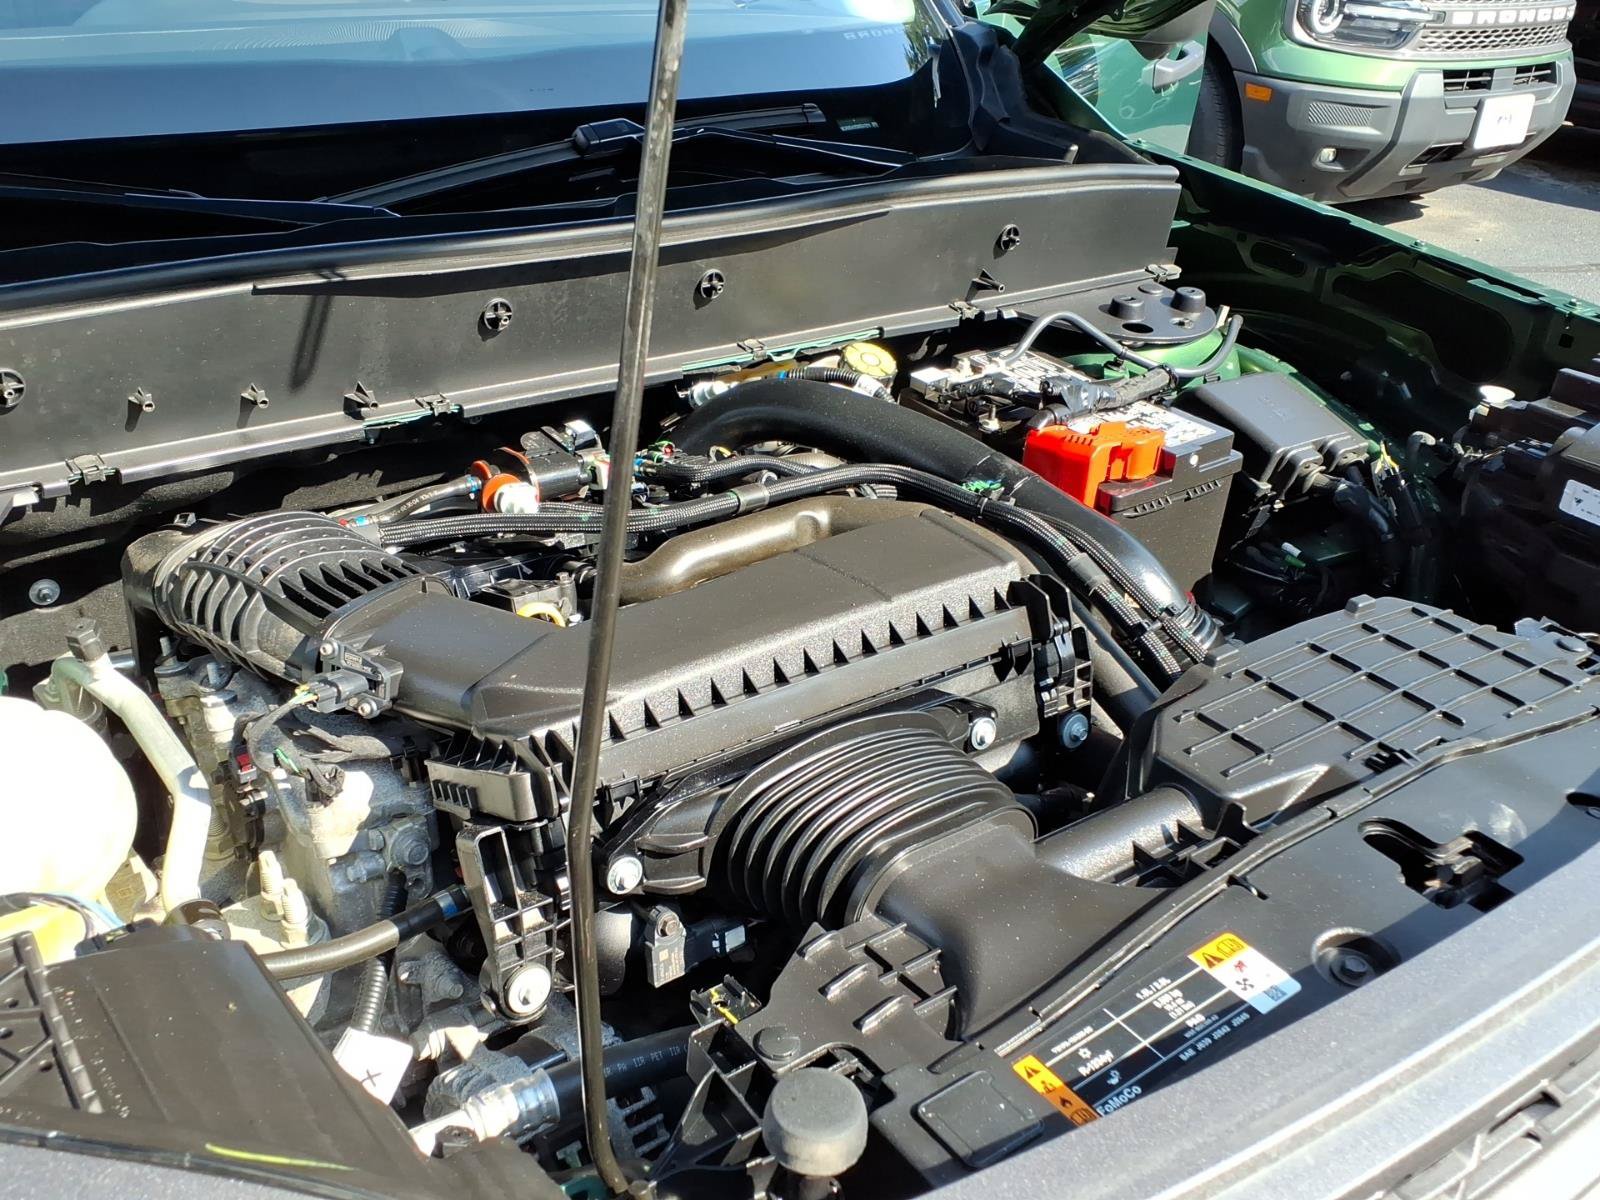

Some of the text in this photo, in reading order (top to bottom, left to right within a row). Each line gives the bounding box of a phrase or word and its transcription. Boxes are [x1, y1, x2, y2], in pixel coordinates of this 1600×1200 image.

[1452, 6, 1567, 25] BRONCO
[649, 1050, 664, 1062] PET
[1096, 1085, 1142, 1118] FoMoCo
